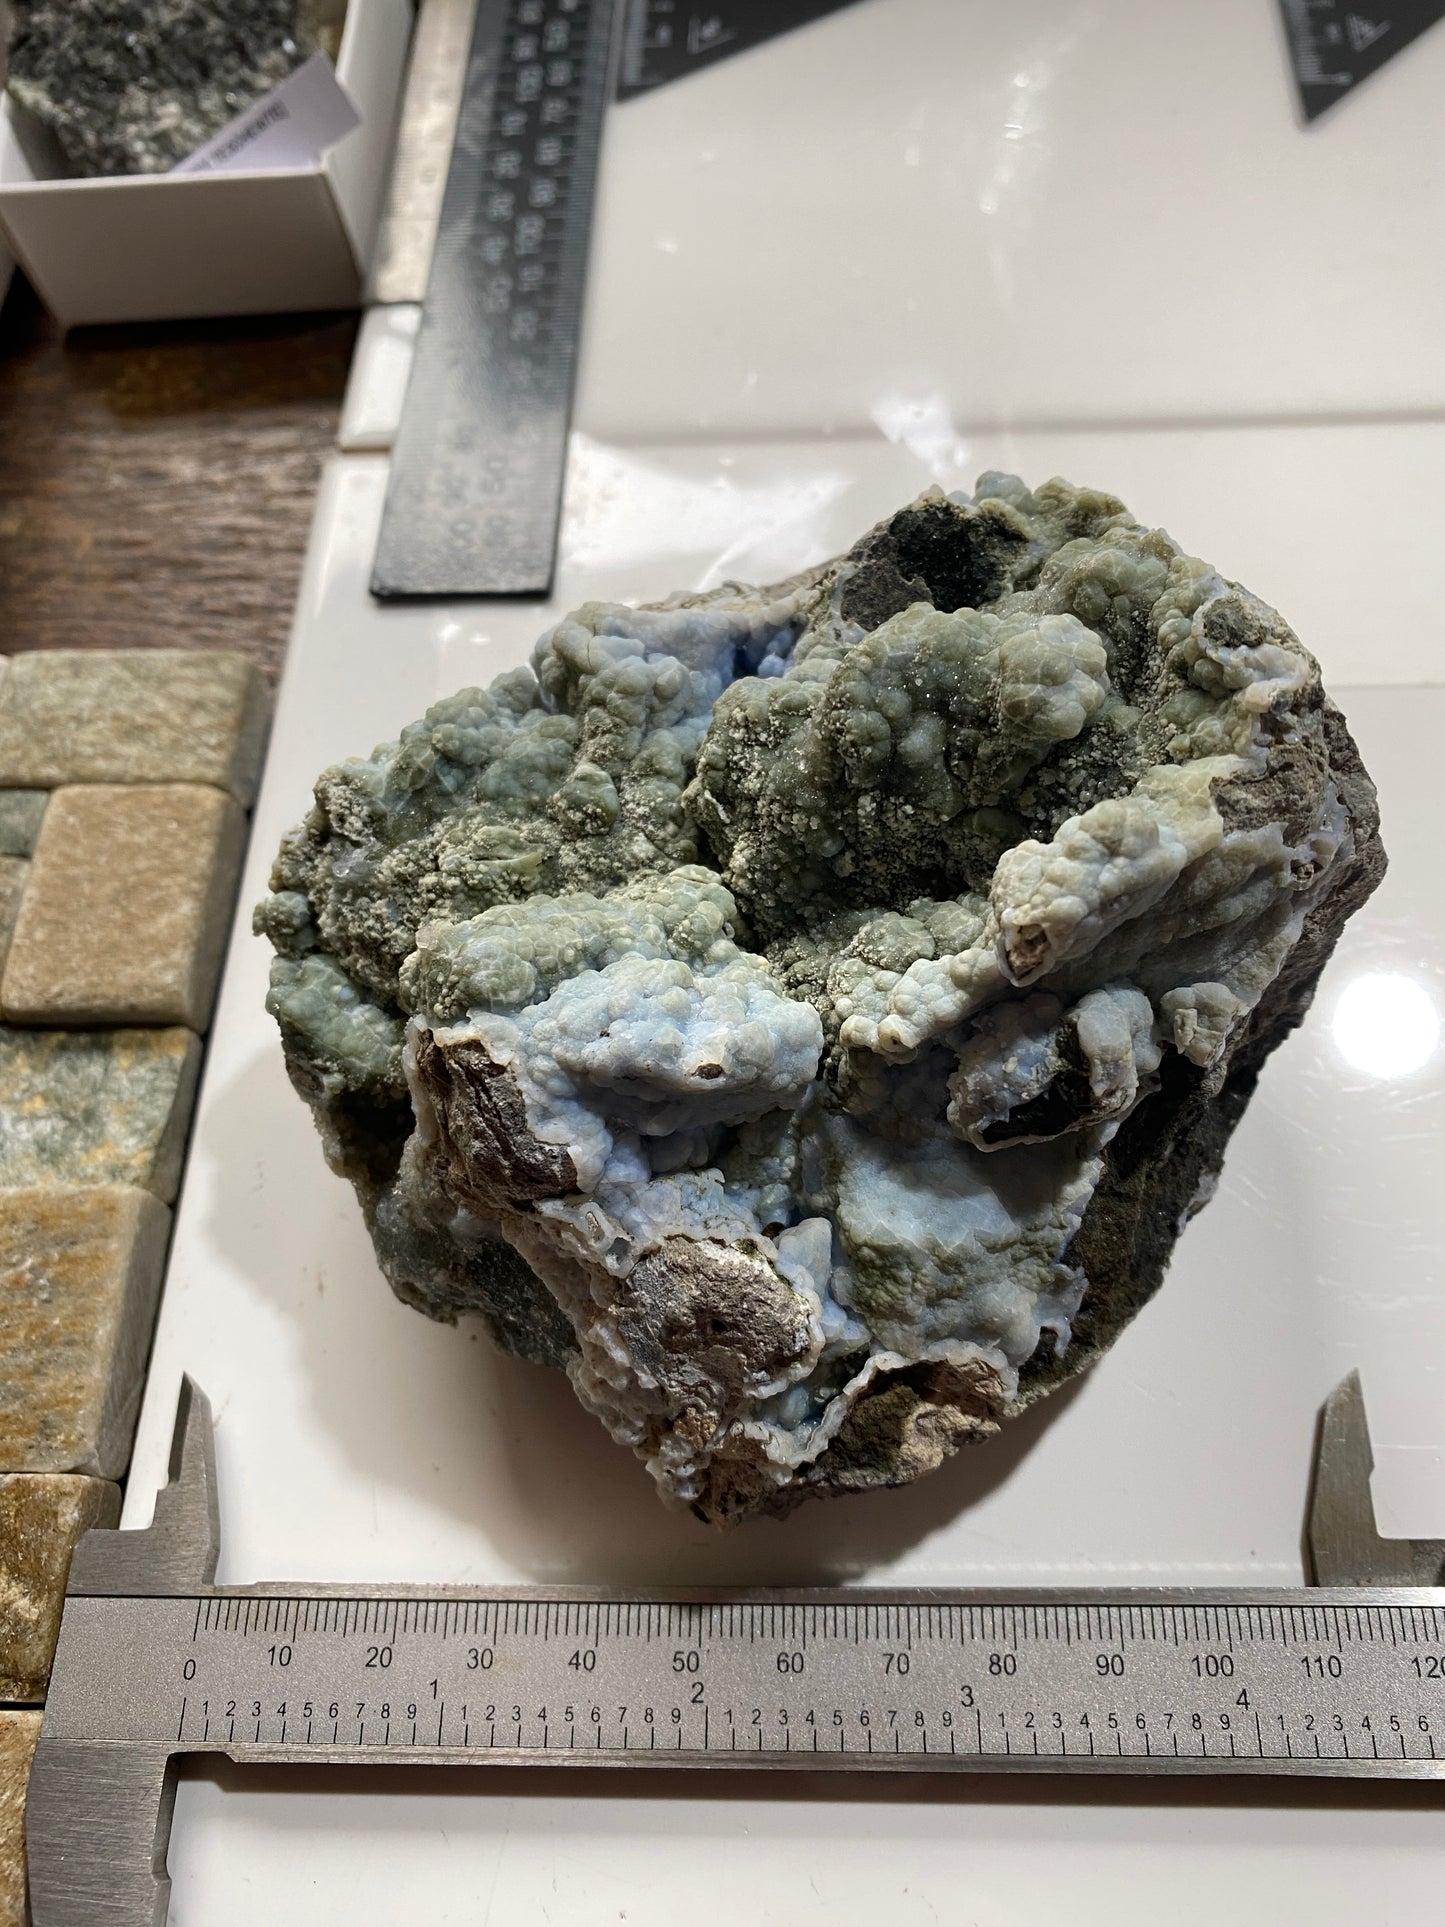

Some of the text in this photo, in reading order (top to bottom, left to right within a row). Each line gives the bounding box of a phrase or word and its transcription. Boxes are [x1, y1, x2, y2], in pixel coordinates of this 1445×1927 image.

[184, 1659, 196, 1680] 0
[268, 1645, 291, 1666] 10
[365, 1646, 392, 1668] 20
[467, 1648, 493, 1669] 30
[568, 1650, 596, 1673] 40
[673, 1651, 699, 1673] 50
[777, 1652, 804, 1674] 60
[883, 1653, 909, 1675] 70
[989, 1654, 1016, 1676] 80
[1096, 1654, 1124, 1676] 90
[1192, 1655, 1234, 1677] 100
[1301, 1655, 1342, 1678] 110
[430, 1679, 1250, 1710] 1 2 3 4
[202, 1699, 1430, 1733] 1 2 3 4 5 6 7 8 9 1 2 3 4 5 6 7 8 9 1 2 3 4 5 6 7 8 9 1 2 3 4 5 6 7 8 9 1 2 3 4 5 6
